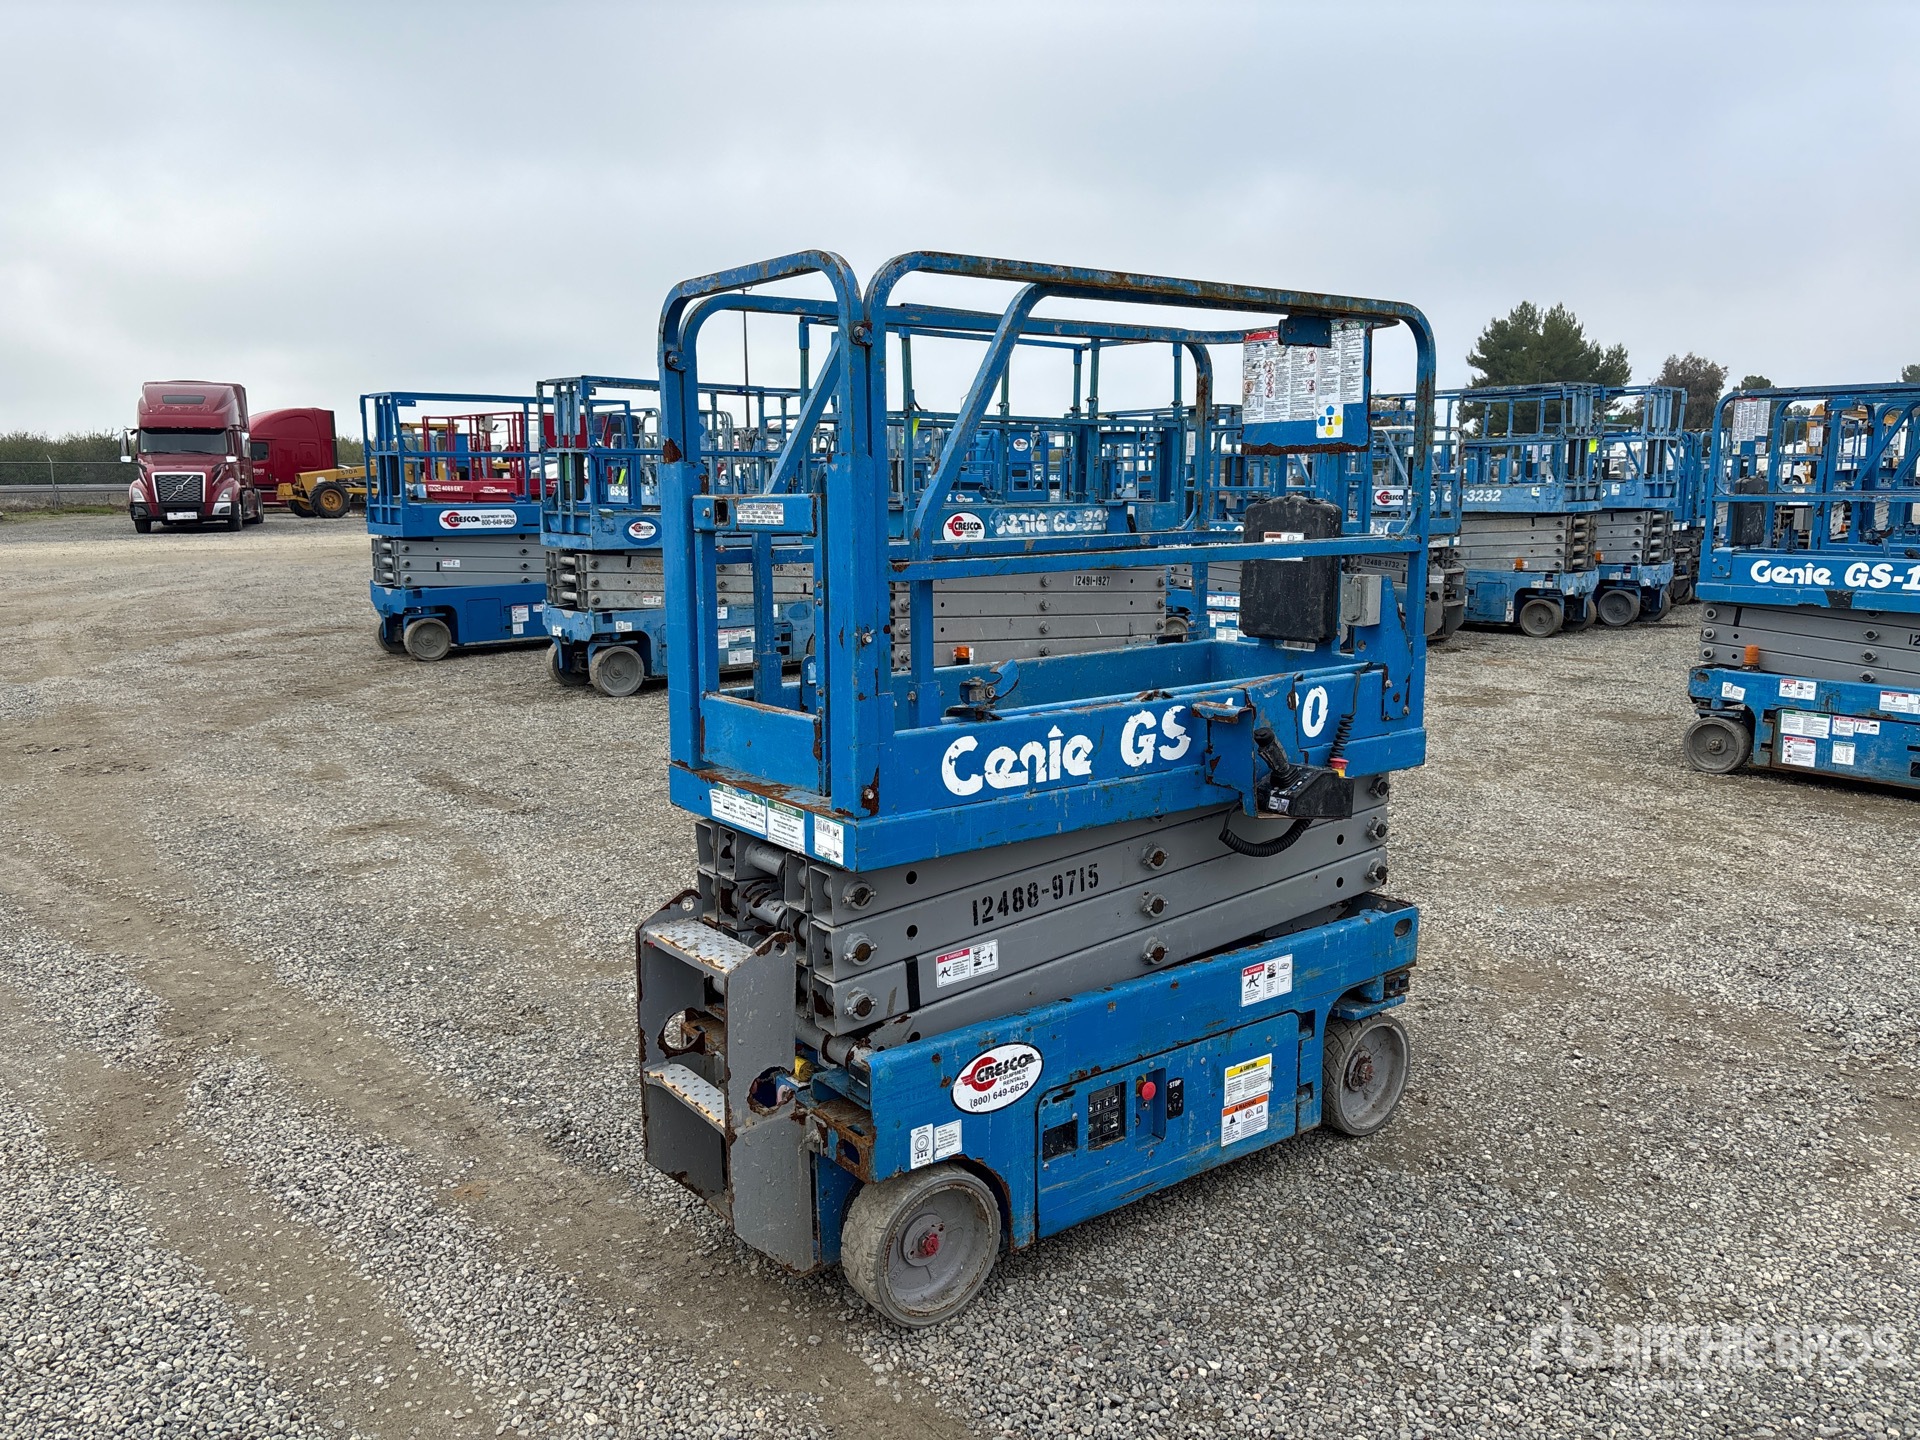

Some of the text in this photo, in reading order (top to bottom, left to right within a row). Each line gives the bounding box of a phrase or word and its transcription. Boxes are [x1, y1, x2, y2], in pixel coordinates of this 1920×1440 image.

[1444, 489, 1502, 502] G-3232
[1751, 560, 1831, 586] Genie
[1074, 575, 1111, 586] 12491-1927
[972, 863, 1099, 926] 12488-9715
[977, 1053, 1036, 1083] CRESCO
[999, 1067, 1029, 1081] EQUIPMENT
[1003, 1074, 1026, 1086] RENTALS
[1169, 1080, 1182, 1089] STOP
[970, 1081, 1029, 1109] (800) 649-6629
